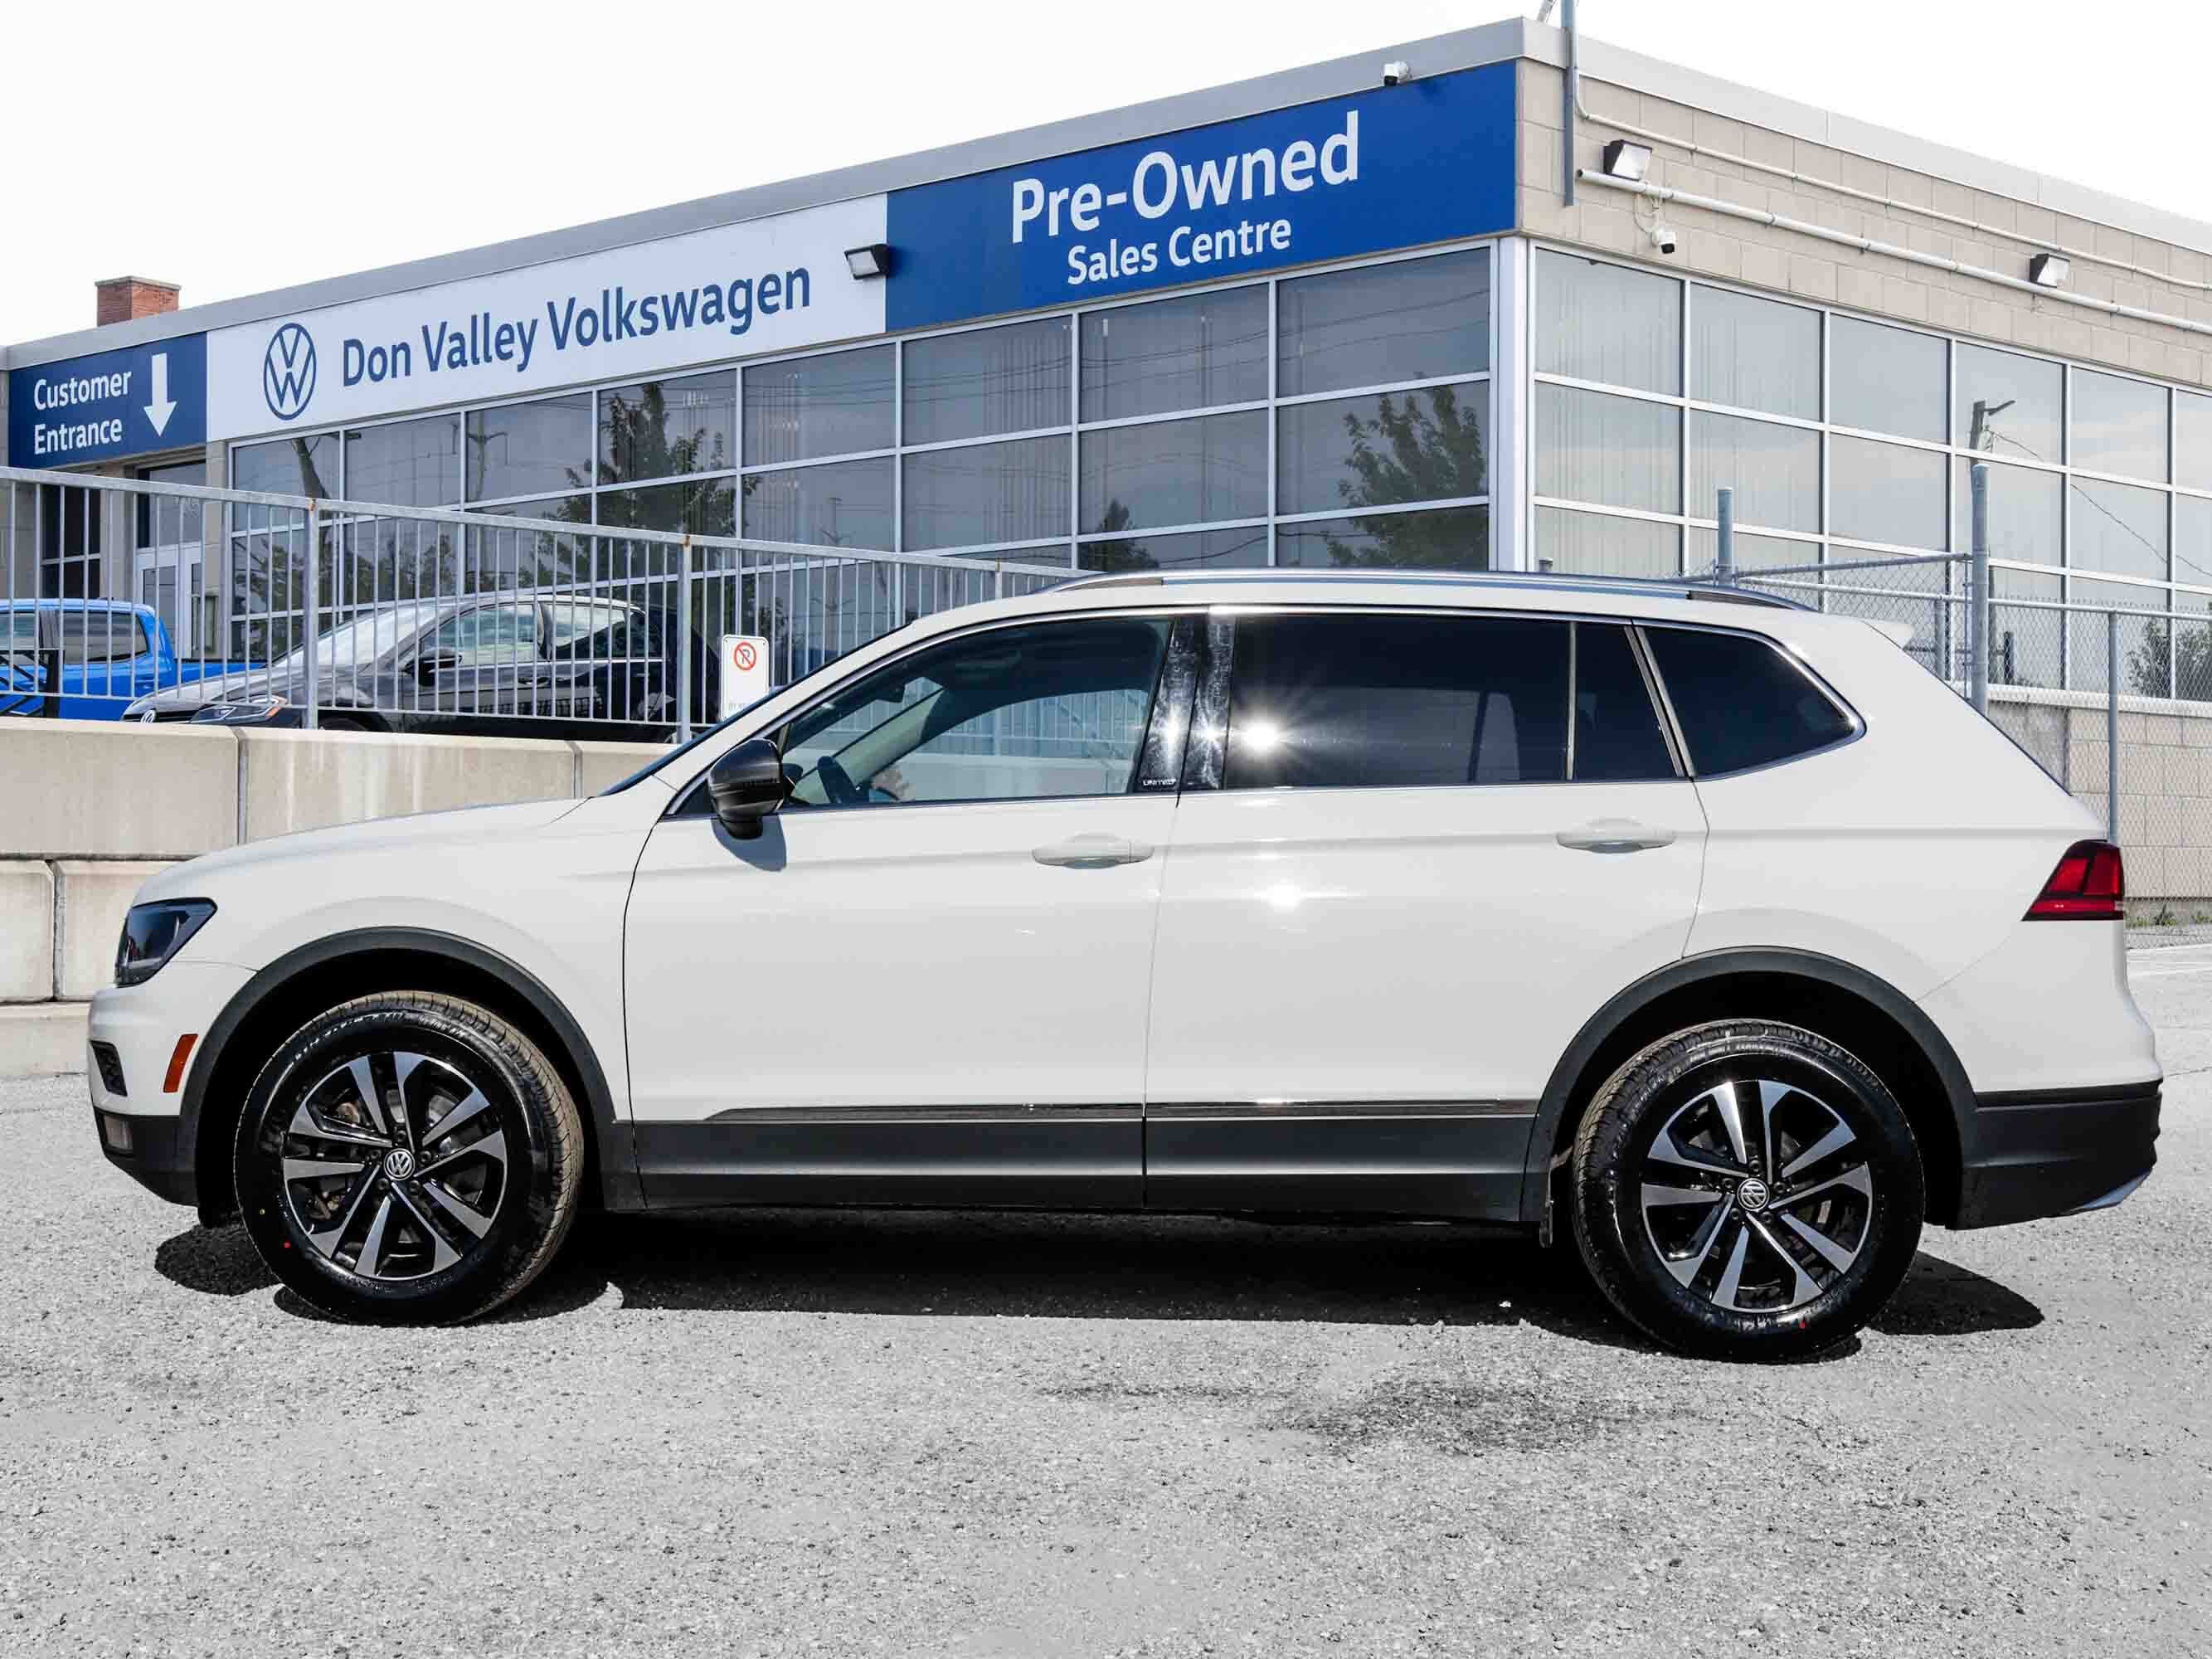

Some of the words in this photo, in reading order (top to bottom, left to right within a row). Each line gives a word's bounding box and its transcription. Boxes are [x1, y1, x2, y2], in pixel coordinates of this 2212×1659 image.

[1013, 110, 1359, 244] Pre-Owned
[1067, 239, 1158, 285] Sales
[1169, 219, 1291, 265] Centre
[343, 338, 411, 387] Don
[422, 312, 538, 372] Valley
[547, 267, 810, 350] Volkswagen
[34, 371, 132, 410] Customer
[265, 324, 316, 419] VW
[34, 418, 123, 455] Entrance
[386, 1151, 413, 1178] VW
